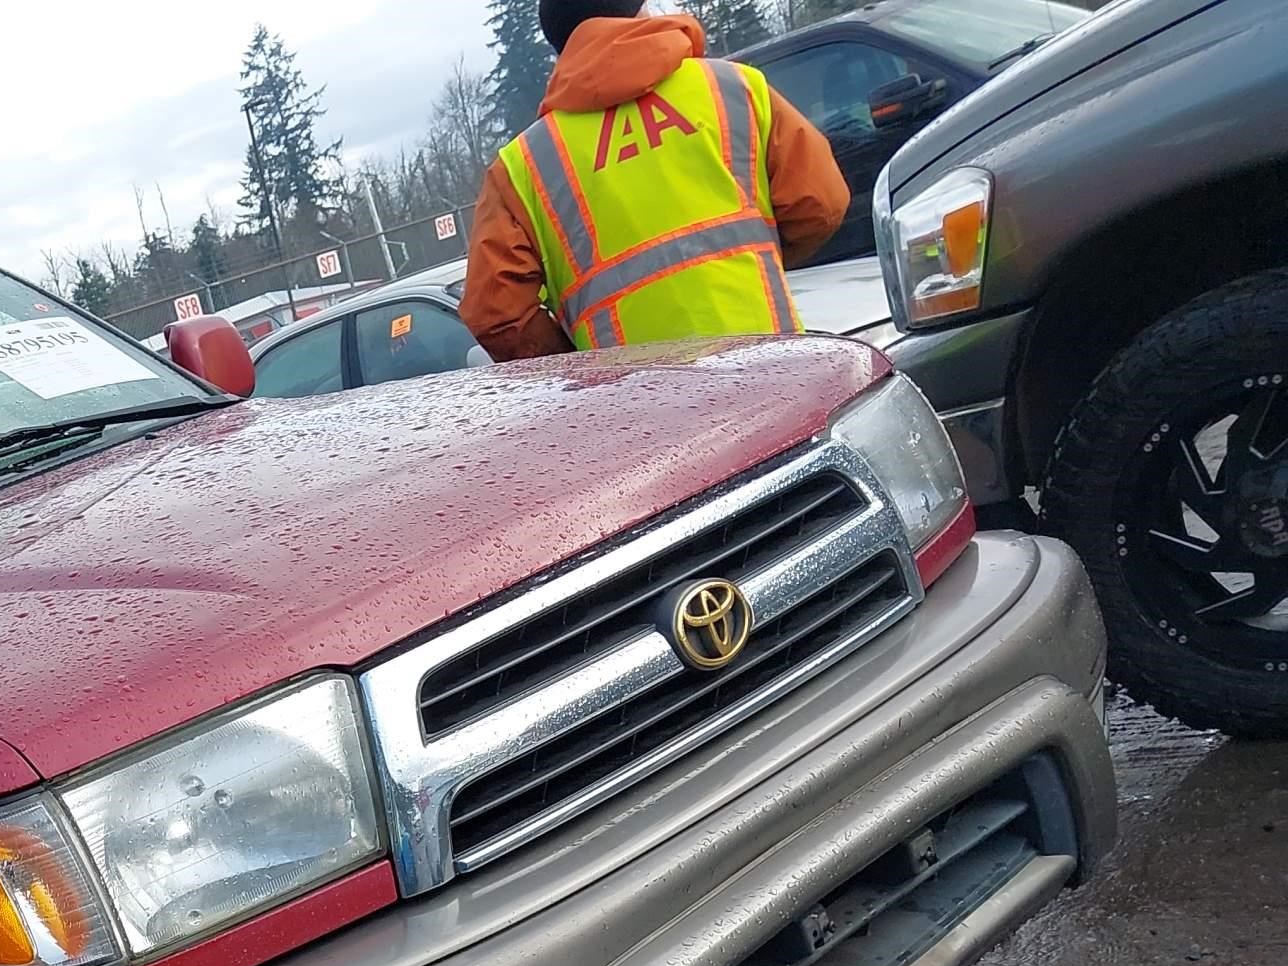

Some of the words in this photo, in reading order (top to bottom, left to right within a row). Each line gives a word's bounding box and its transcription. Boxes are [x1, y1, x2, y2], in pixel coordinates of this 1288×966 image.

[594, 90, 698, 173] IAA
[319, 254, 337, 274] SF7
[177, 296, 200, 320] SF8
